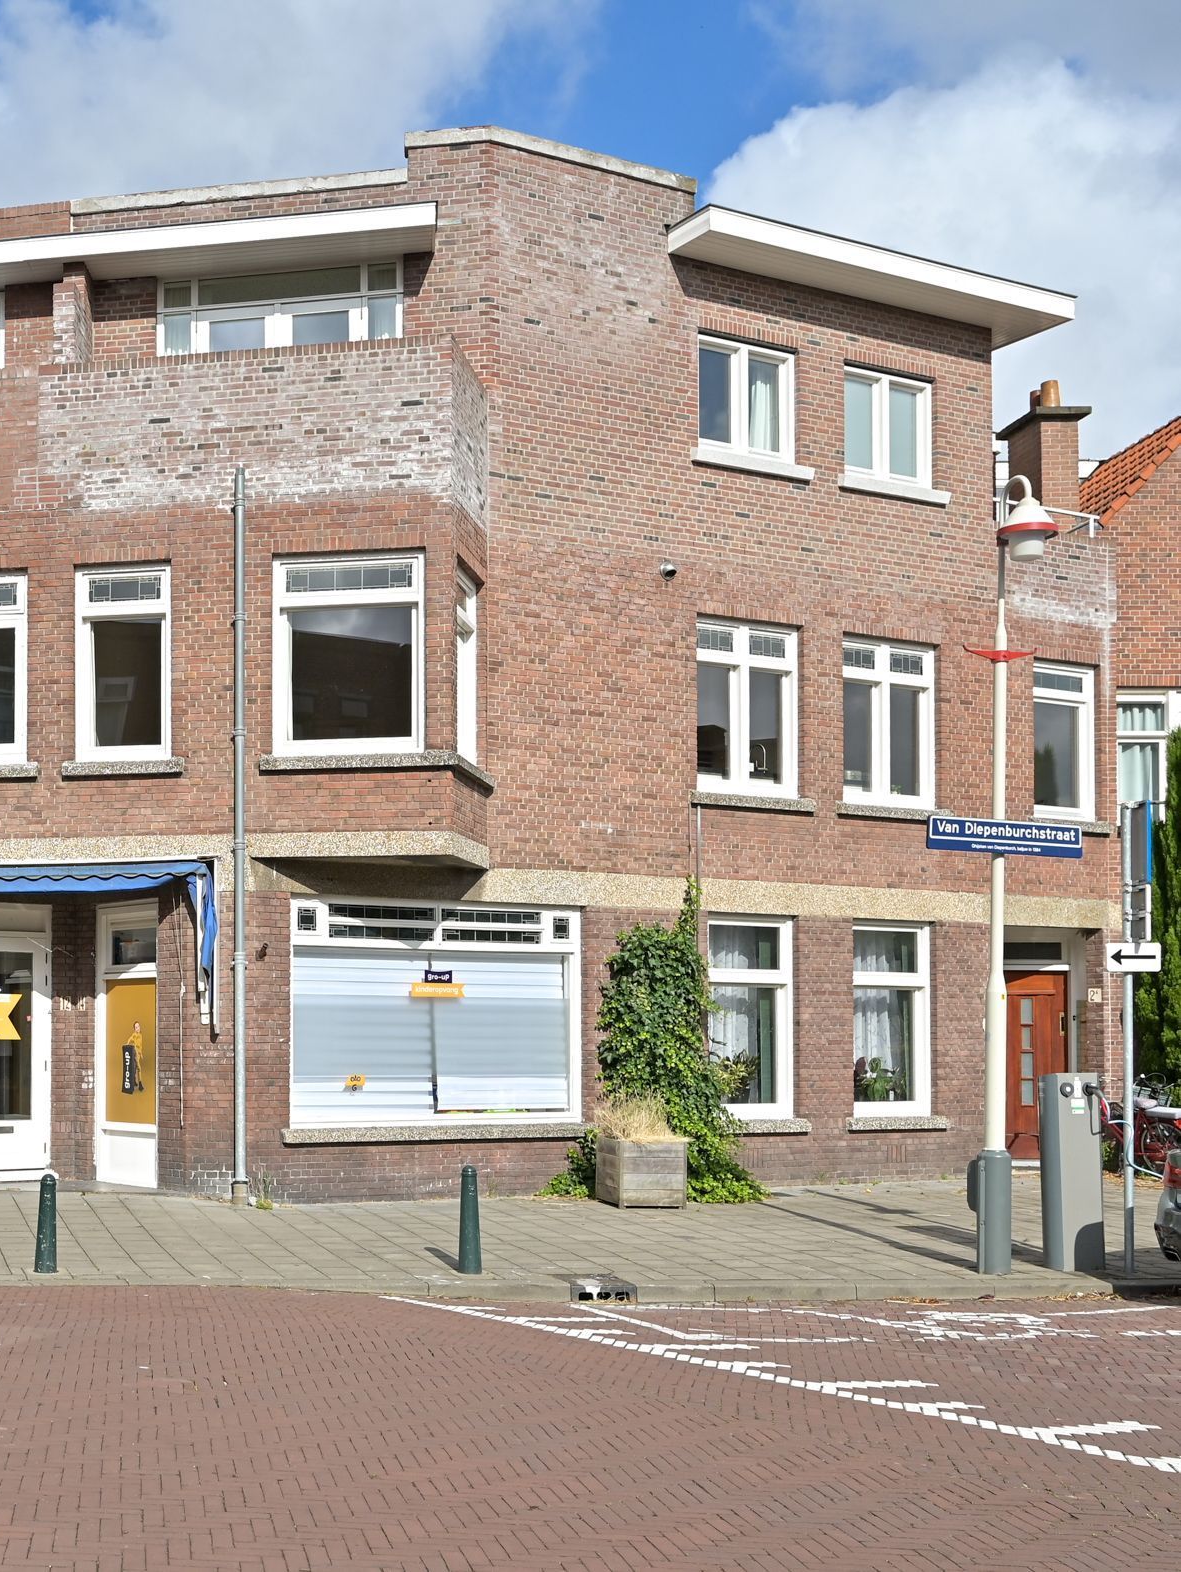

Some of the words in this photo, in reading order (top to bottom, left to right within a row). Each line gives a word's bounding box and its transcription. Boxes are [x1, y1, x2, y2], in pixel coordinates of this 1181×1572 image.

[937, 820, 959, 834] Van
[965, 822, 1075, 841] Diepenburchstraat
[427, 973, 450, 982] gro-up
[416, 986, 458, 995] kinderopvang
